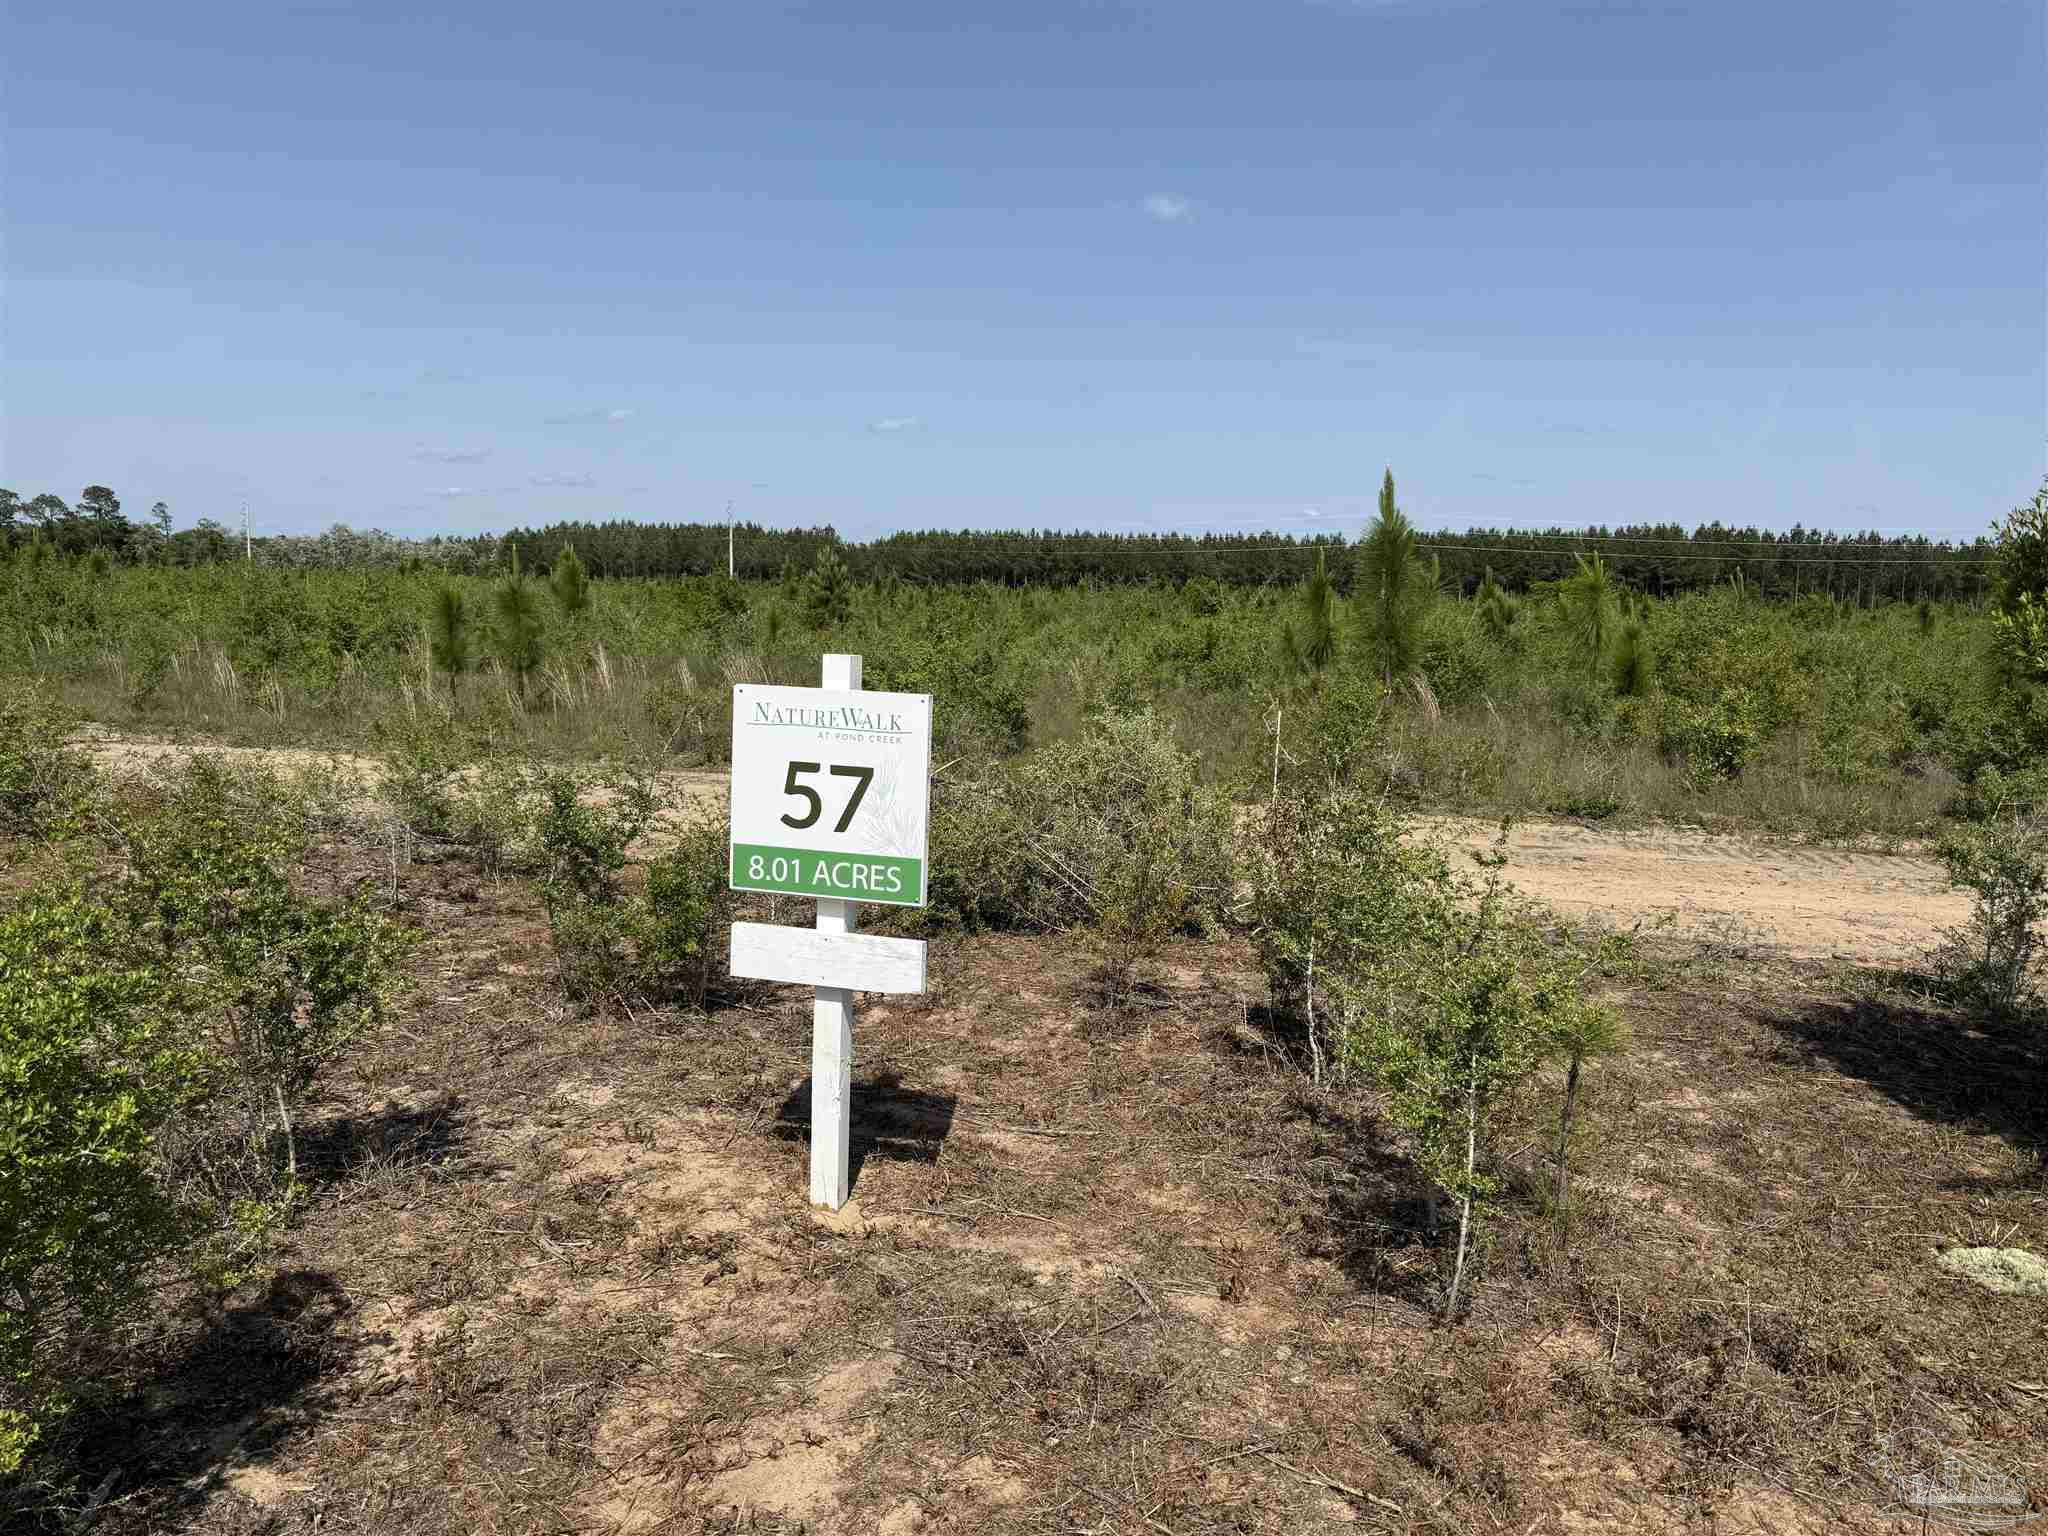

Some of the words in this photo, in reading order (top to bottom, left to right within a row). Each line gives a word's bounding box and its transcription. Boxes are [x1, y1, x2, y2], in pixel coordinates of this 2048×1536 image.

[817, 731, 830, 742] AT
[835, 732, 864, 744] POND
[868, 734, 903, 745] CREEK
[780, 761, 874, 833] 57
[749, 855, 801, 883] 8.01
[811, 860, 902, 893] ACRES
